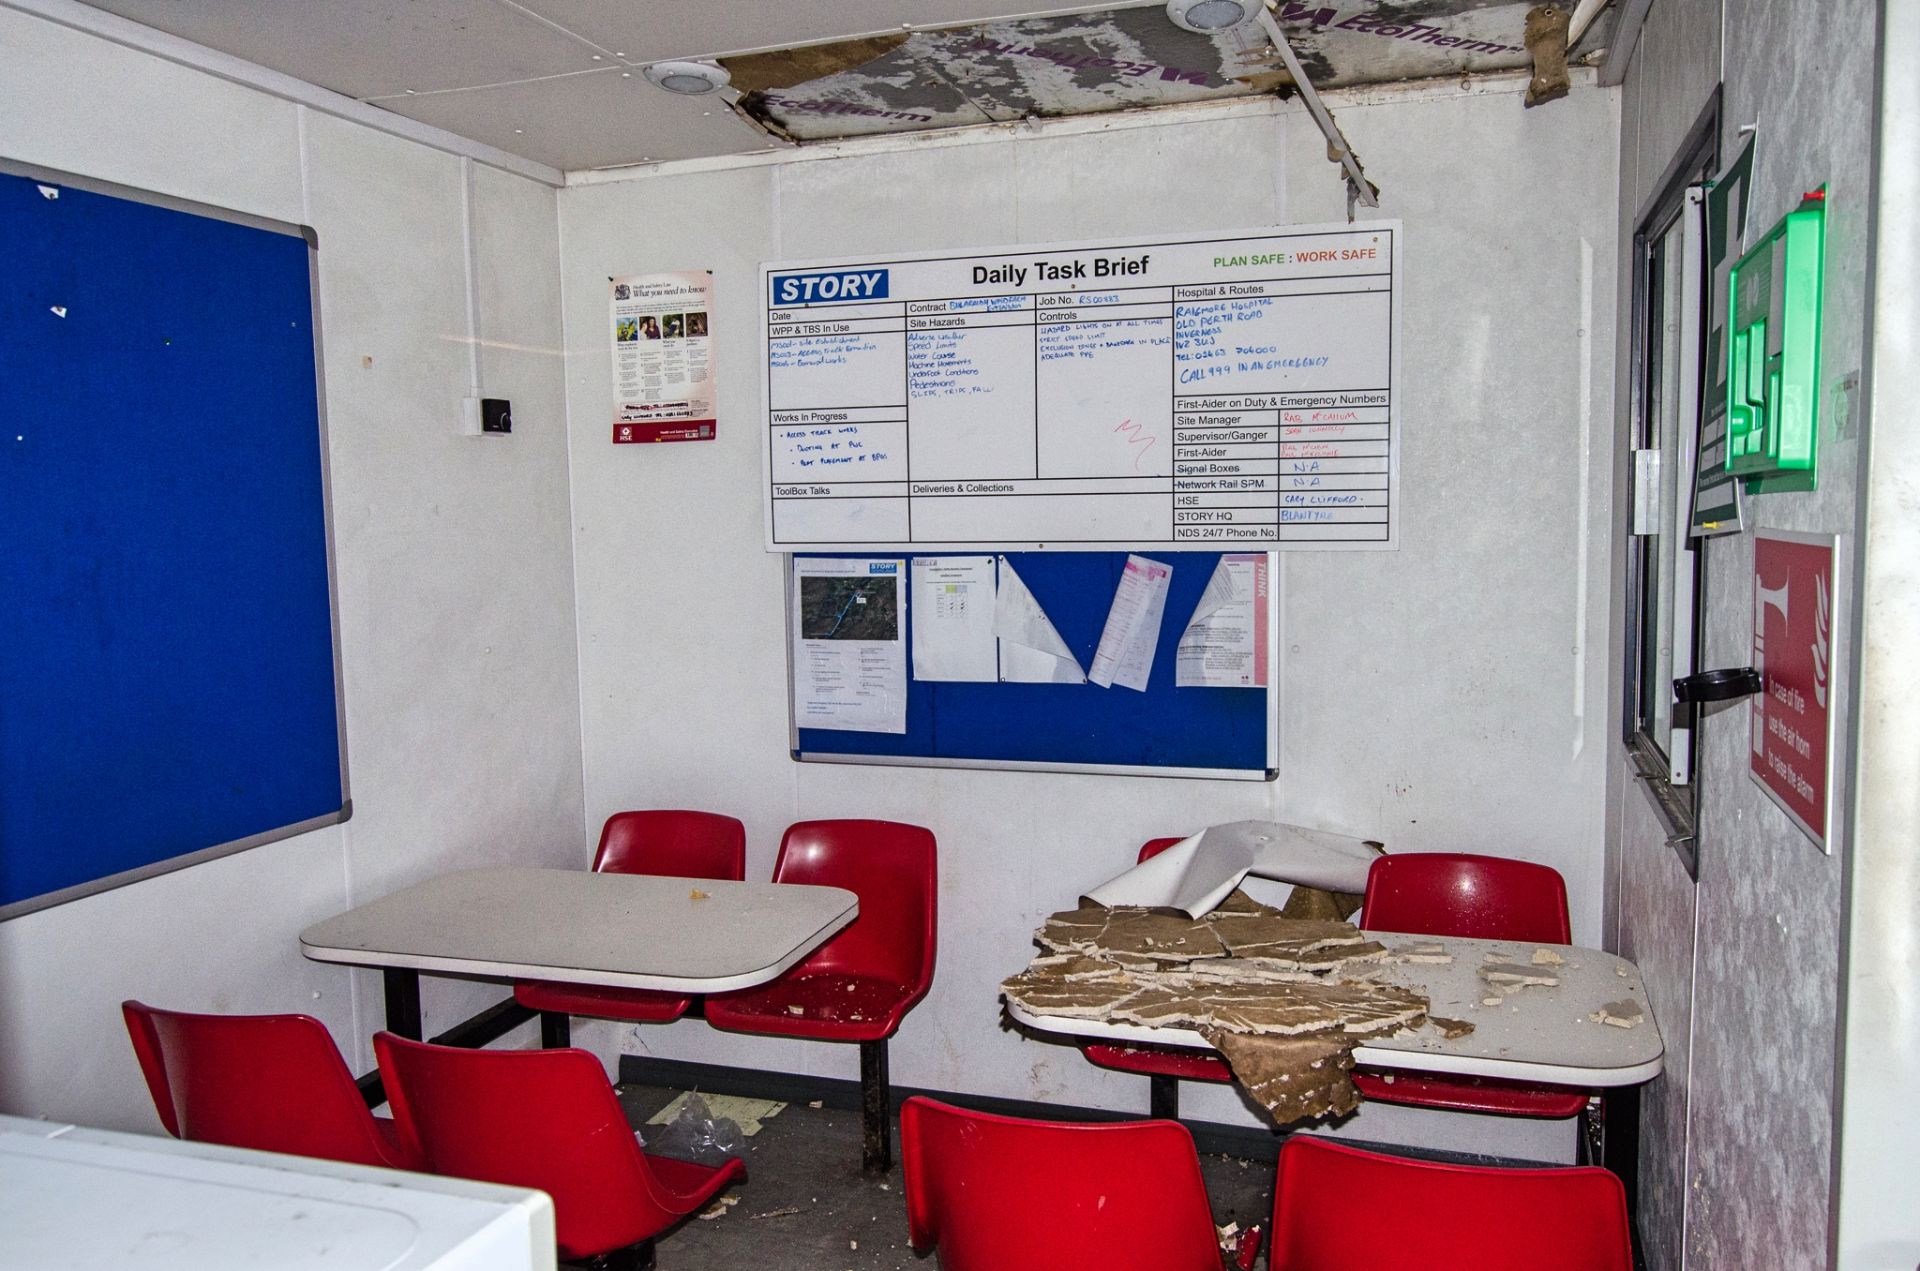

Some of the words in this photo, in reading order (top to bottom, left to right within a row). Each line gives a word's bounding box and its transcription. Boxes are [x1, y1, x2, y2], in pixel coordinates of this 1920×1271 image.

[1214, 256, 1248, 268] PLAN
[1251, 254, 1284, 266] SAFE
[1296, 250, 1338, 263] WORK
[1342, 248, 1376, 260] SAFE
[972, 265, 1027, 287] Daily
[1034, 261, 1086, 280] Task
[1094, 256, 1150, 278] Brief
[633, 289, 650, 297] What
[664, 287, 678, 295] need
[688, 286, 707, 294] know
[781, 272, 882, 301] STORY
[1177, 287, 1216, 298] Hospital
[1219, 287, 1226, 295] &
[1229, 285, 1264, 294] Routes
[1039, 296, 1056, 306] Job
[1058, 296, 1074, 304] No.
[910, 302, 946, 313] Contract
[772, 312, 790, 321] Date
[1039, 312, 1077, 322] Controls
[910, 320, 926, 328] Site
[930, 318, 966, 327] Hazards
[772, 326, 792, 335] WPP
[803, 325, 820, 334] TBS
[1180, 368, 1206, 384] CALL
[1178, 399, 1227, 409] First-Aider
[1244, 398, 1268, 410] Duty
[1270, 397, 1278, 406] &
[1280, 396, 1337, 408] Emergency
[1340, 394, 1386, 404] Numbers
[773, 412, 799, 422] Works
[801, 412, 808, 422] In
[810, 412, 848, 424] Progress
[1178, 416, 1194, 424] Site
[1197, 415, 1240, 426] Manager
[1178, 430, 1268, 442] Supervisor/Ganger
[1178, 448, 1226, 457] First-Aider
[1178, 464, 1207, 474] Signal
[1210, 463, 1240, 472] Boxes
[913, 484, 954, 493] Deliveries
[957, 484, 964, 492] &
[966, 482, 1014, 492] Collections
[1178, 480, 1216, 488] Network
[1218, 479, 1238, 488] Rail
[1240, 479, 1265, 488] SPM
[776, 486, 807, 495] ToolBox
[809, 486, 830, 495] Talks
[1178, 496, 1199, 505] HSE
[1178, 512, 1214, 521] STORY
[1216, 512, 1232, 522] HQ
[1178, 528, 1200, 538] NDS
[1202, 528, 1224, 538] 24/7
[1226, 528, 1258, 538] Phone
[1260, 528, 1278, 538] No.
[1258, 562, 1267, 598] THINK
[1775, 681, 1787, 704] case
[1788, 688, 1794, 706] of
[1794, 689, 1804, 715] fire
[1768, 714, 1778, 734] use
[1778, 717, 1787, 742] the
[1796, 727, 1810, 760] horn
[1768, 747, 1774, 768] to
[1774, 754, 1787, 780] raise
[1788, 763, 1796, 789] the
[1796, 772, 1814, 804] alarm
